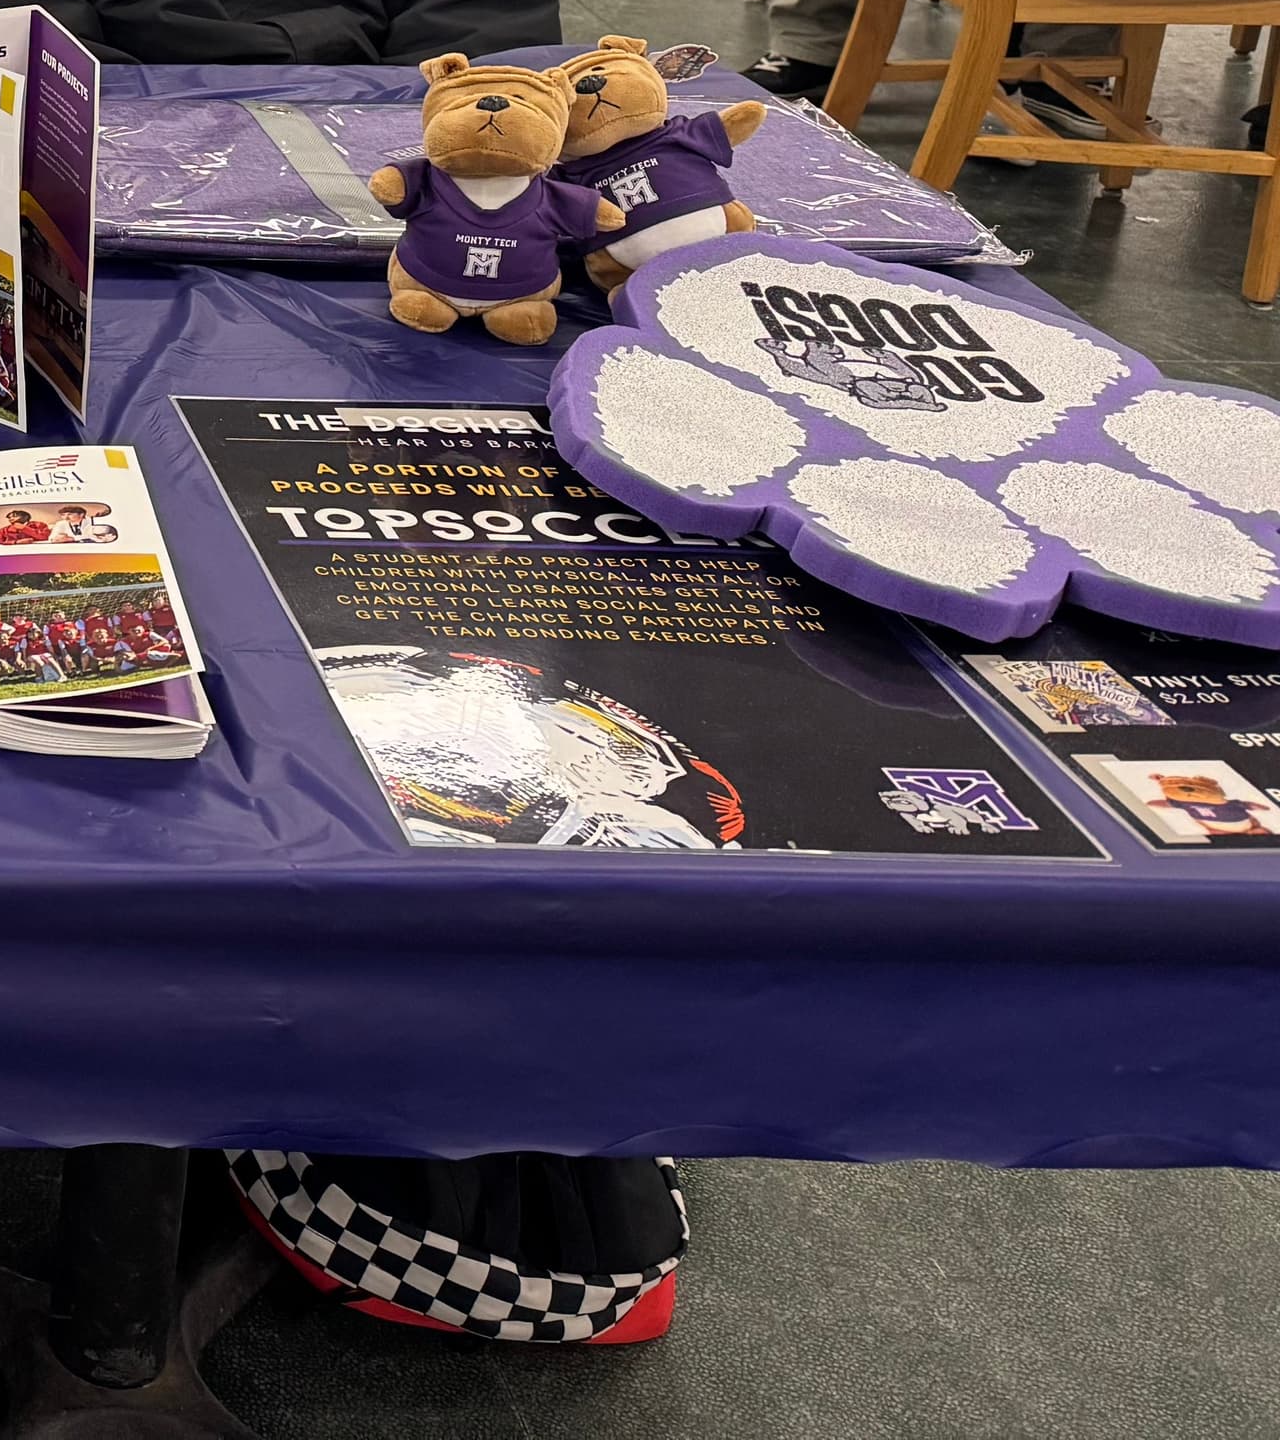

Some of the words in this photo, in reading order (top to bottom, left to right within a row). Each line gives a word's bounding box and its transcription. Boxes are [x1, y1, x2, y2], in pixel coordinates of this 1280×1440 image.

[42, 49, 57, 72] OUR
[57, 63, 89, 101] PROJECTS
[595, 167, 630, 190] MONTY
[630, 158, 658, 174] TECH
[456, 234, 491, 246] MONTY
[494, 237, 518, 248] TECH
[741, 281, 996, 352] DOGS!
[907, 354, 1046, 403] GO
[261, 412, 350, 432] THE
[357, 437, 428, 449] HEAR
[440, 438, 472, 449] US
[491, 439, 557, 450] BARK
[316, 463, 338, 475] A
[348, 464, 506, 478] PORTION
[518, 466, 560, 479] OF
[270, 480, 457, 496] PROCEEDS
[466, 483, 554, 498] WILL
[331, 553, 346, 563] A
[353, 553, 533, 566] STUDENT-LEAD
[541, 557, 648, 568] PROJECT
[657, 559, 691, 569] TO
[699, 560, 760, 571] HELP
[314, 566, 436, 578] CHILDREN
[443, 569, 507, 579] WITH
[766, 576, 801, 587] OR
[355, 581, 500, 593] EMOTIONAL
[507, 584, 667, 597] DISABILITIES
[675, 588, 721, 598] GET
[729, 589, 781, 600] THE
[336, 595, 439, 607] CHANCE
[445, 597, 478, 607] TO
[488, 597, 568, 609] LEARN
[576, 600, 668, 611] SOCIAL
[675, 602, 761, 614] SKILLS
[771, 605, 821, 616] AND
[355, 610, 401, 620] GET
[410, 611, 462, 622] THE
[470, 611, 574, 624] CHANCE
[579, 614, 613, 625] TO
[622, 616, 790, 630] PARTICIPATE
[796, 621, 825, 632] IN
[425, 625, 496, 637] TEAM
[505, 628, 620, 640] BONDING
[629, 631, 776, 645] EXERCISES.
[1052, 663, 1102, 683] MONTY
[1132, 675, 1223, 688] VINYL
[1159, 692, 1230, 705] $2.00
